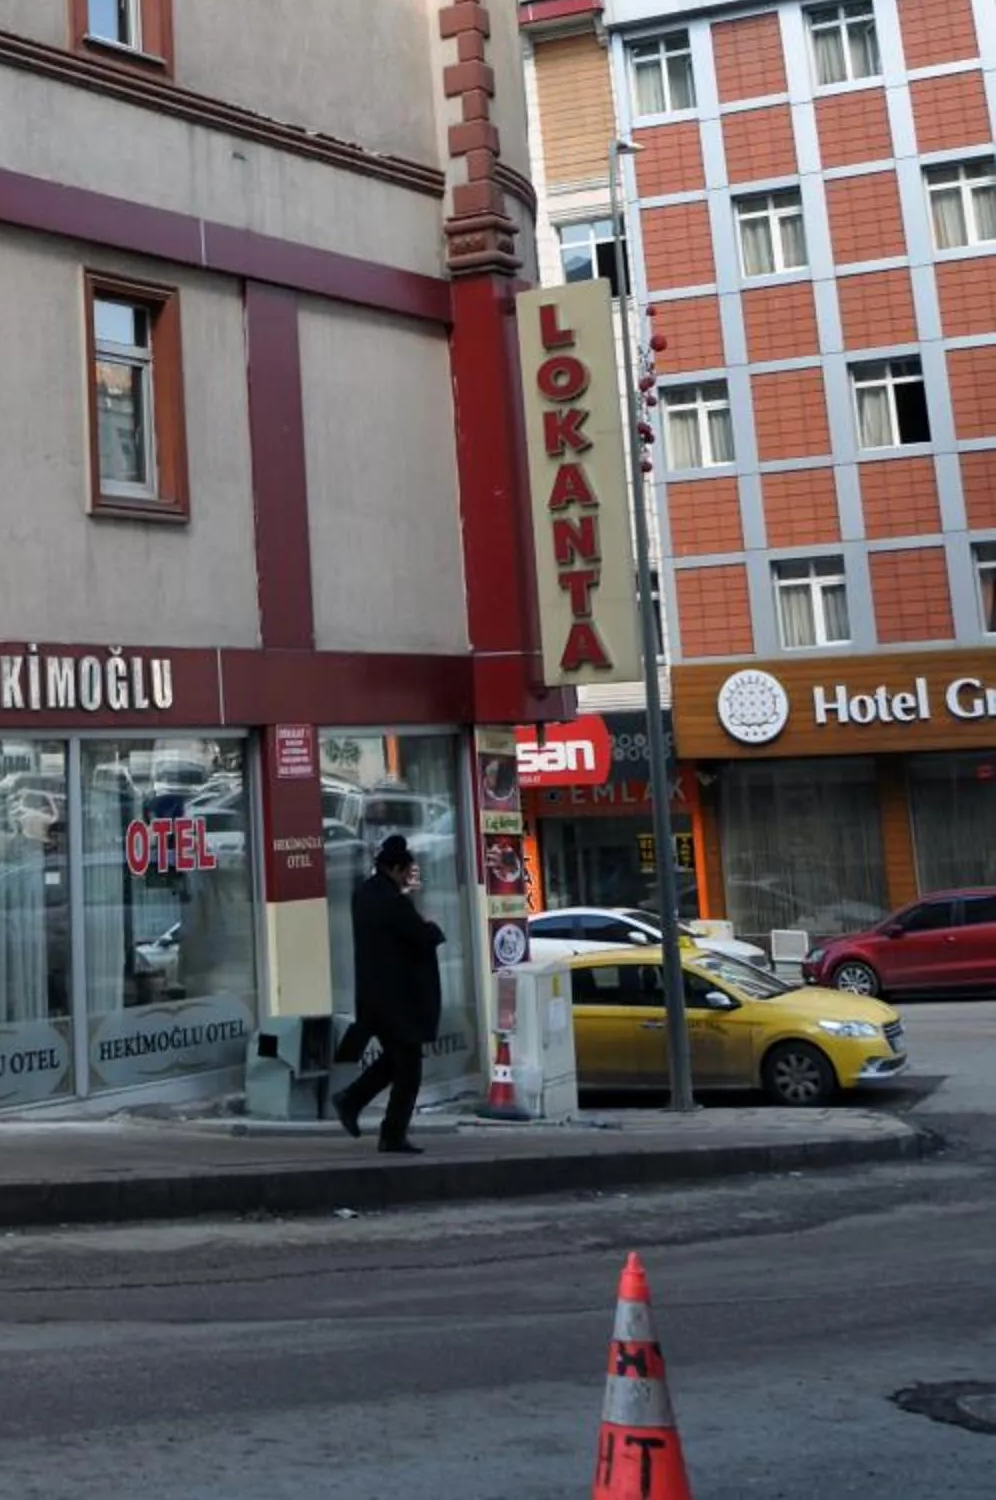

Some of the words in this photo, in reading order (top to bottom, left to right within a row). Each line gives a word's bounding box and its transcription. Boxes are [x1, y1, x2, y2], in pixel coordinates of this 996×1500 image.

[537, 303, 611, 672] LOKANTA
[812, 677, 932, 725] Hotel
[126, 816, 217, 875] OTEL
[10, 1049, 61, 1076] OTEL
[99, 1025, 203, 1061] HEKİMOĞLU
[206, 1018, 249, 1045] OTEL
